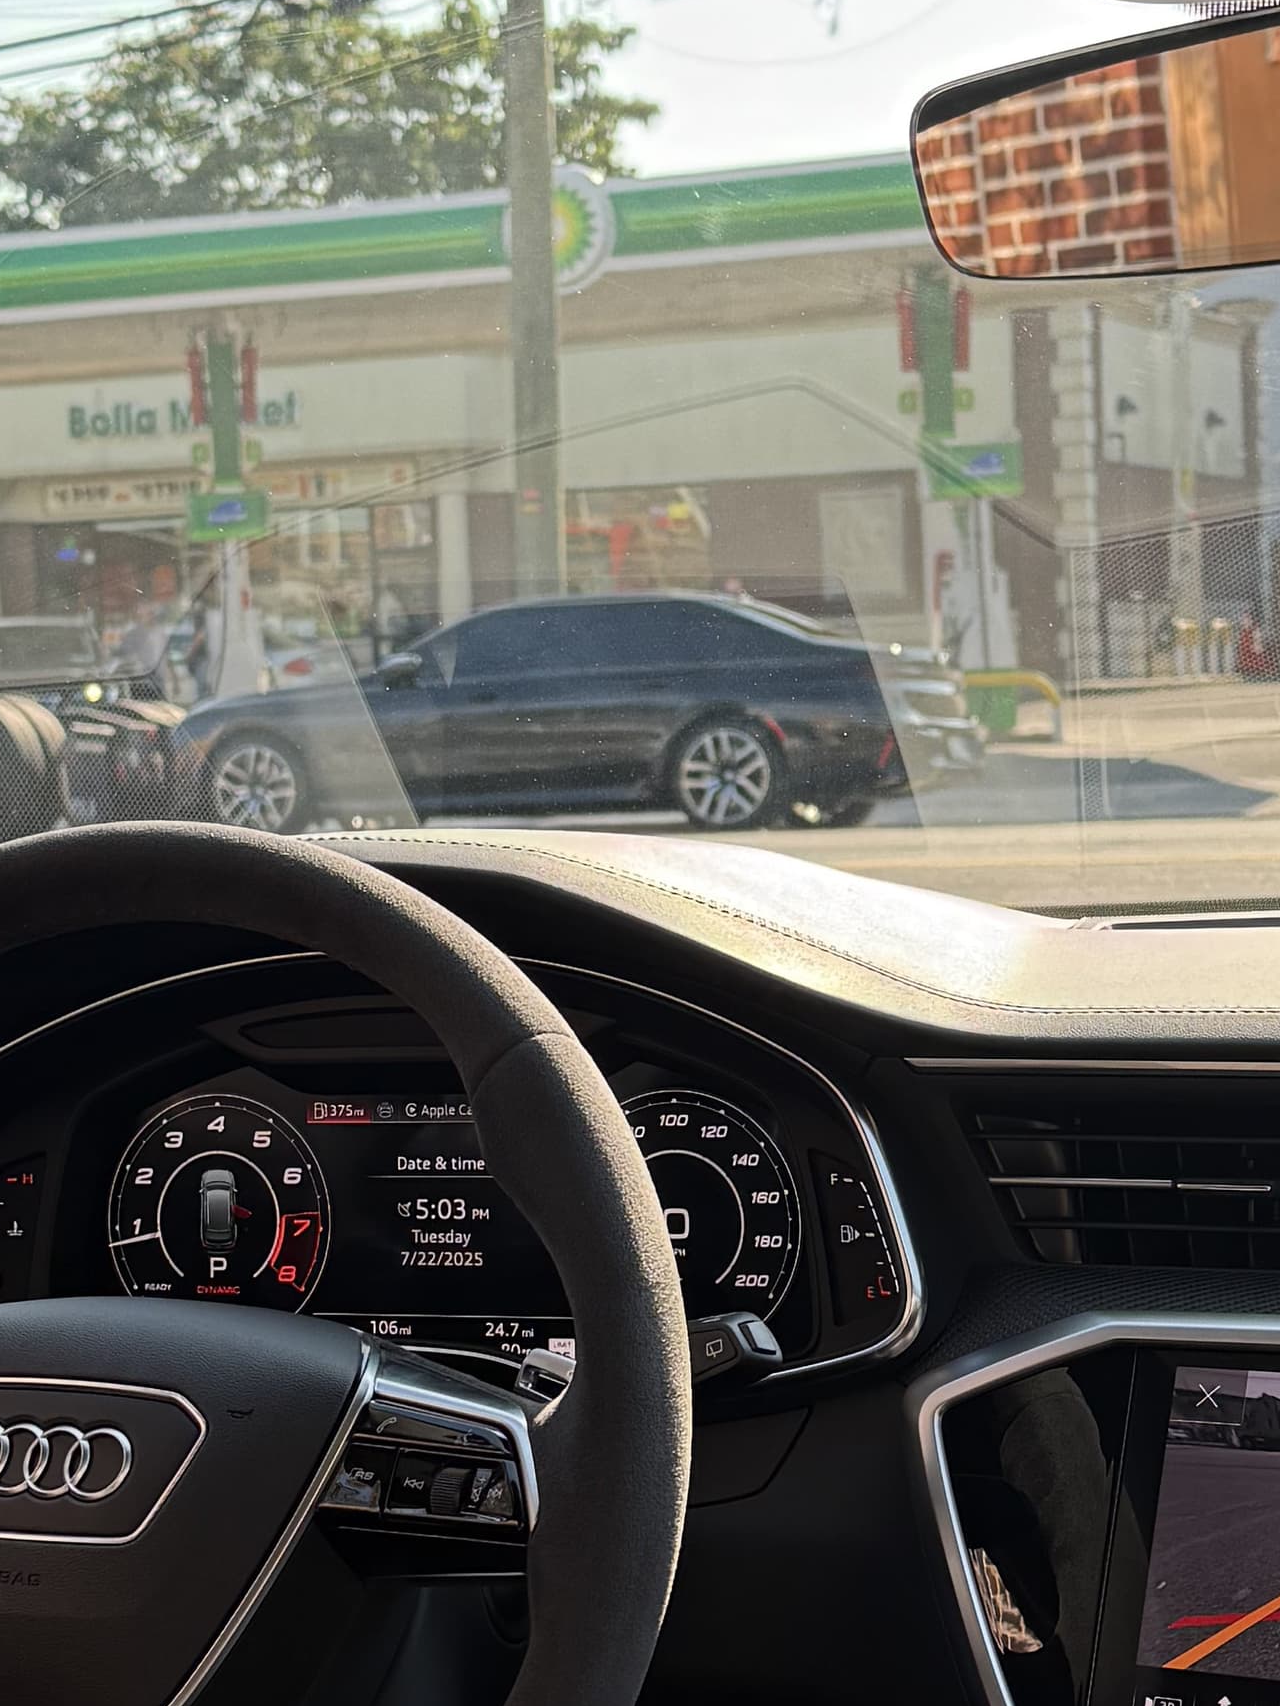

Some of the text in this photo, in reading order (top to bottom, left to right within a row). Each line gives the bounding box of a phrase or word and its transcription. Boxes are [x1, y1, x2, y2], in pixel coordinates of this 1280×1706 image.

[169, 391, 298, 433] Met
[421, 1103, 456, 1120] Apple
[207, 1115, 225, 1133] 4
[659, 1114, 689, 1127] 100
[164, 1131, 183, 1148] 3
[252, 1130, 271, 1147] 5
[700, 1125, 728, 1138] 120
[397, 1156, 486, 1171] Date & time
[732, 1153, 759, 1167] 140
[22, 1173, 34, 1186] H
[134, 1168, 154, 1185] 2
[283, 1167, 302, 1185] 6
[830, 1173, 839, 1185] F
[751, 1191, 780, 1205] 160
[415, 1198, 490, 1220] 5:03 PM
[132, 1218, 142, 1235] 1
[292, 1219, 311, 1237] 7
[411, 1229, 471, 1247] Tuesday
[754, 1234, 783, 1249] 180
[400, 1251, 484, 1267] 7/22/2025
[209, 1257, 227, 1279] P
[277, 1265, 297, 1283] 8
[734, 1274, 769, 1287] 200
[866, 1286, 876, 1299] E
[485, 1322, 519, 1337] 24.7
